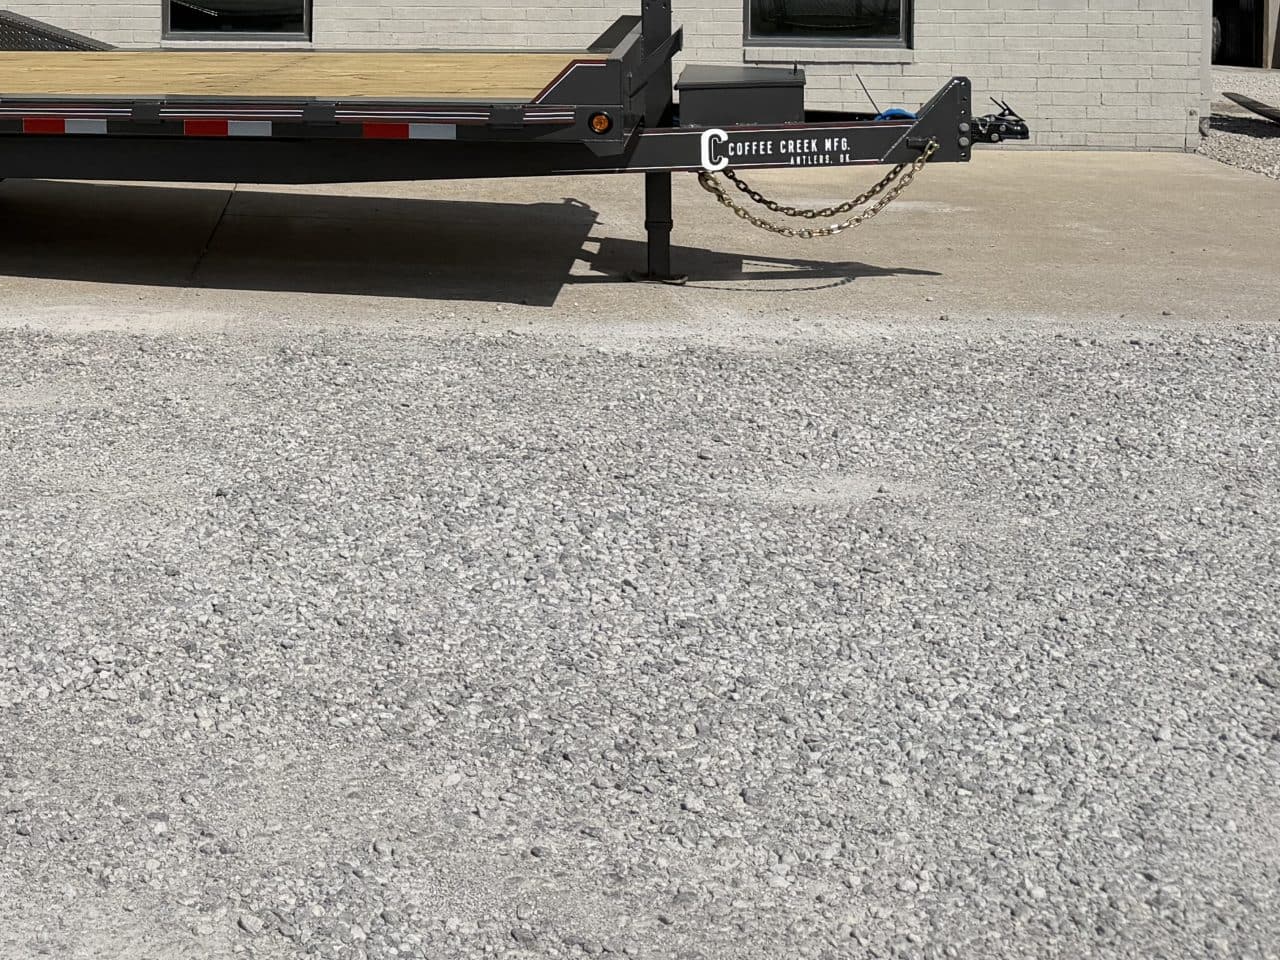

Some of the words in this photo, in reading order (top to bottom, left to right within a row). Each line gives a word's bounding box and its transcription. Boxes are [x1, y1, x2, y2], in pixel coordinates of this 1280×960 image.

[728, 141, 773, 156] COFFEE
[780, 139, 818, 154] CREEK
[824, 137, 851, 152] MFG.
